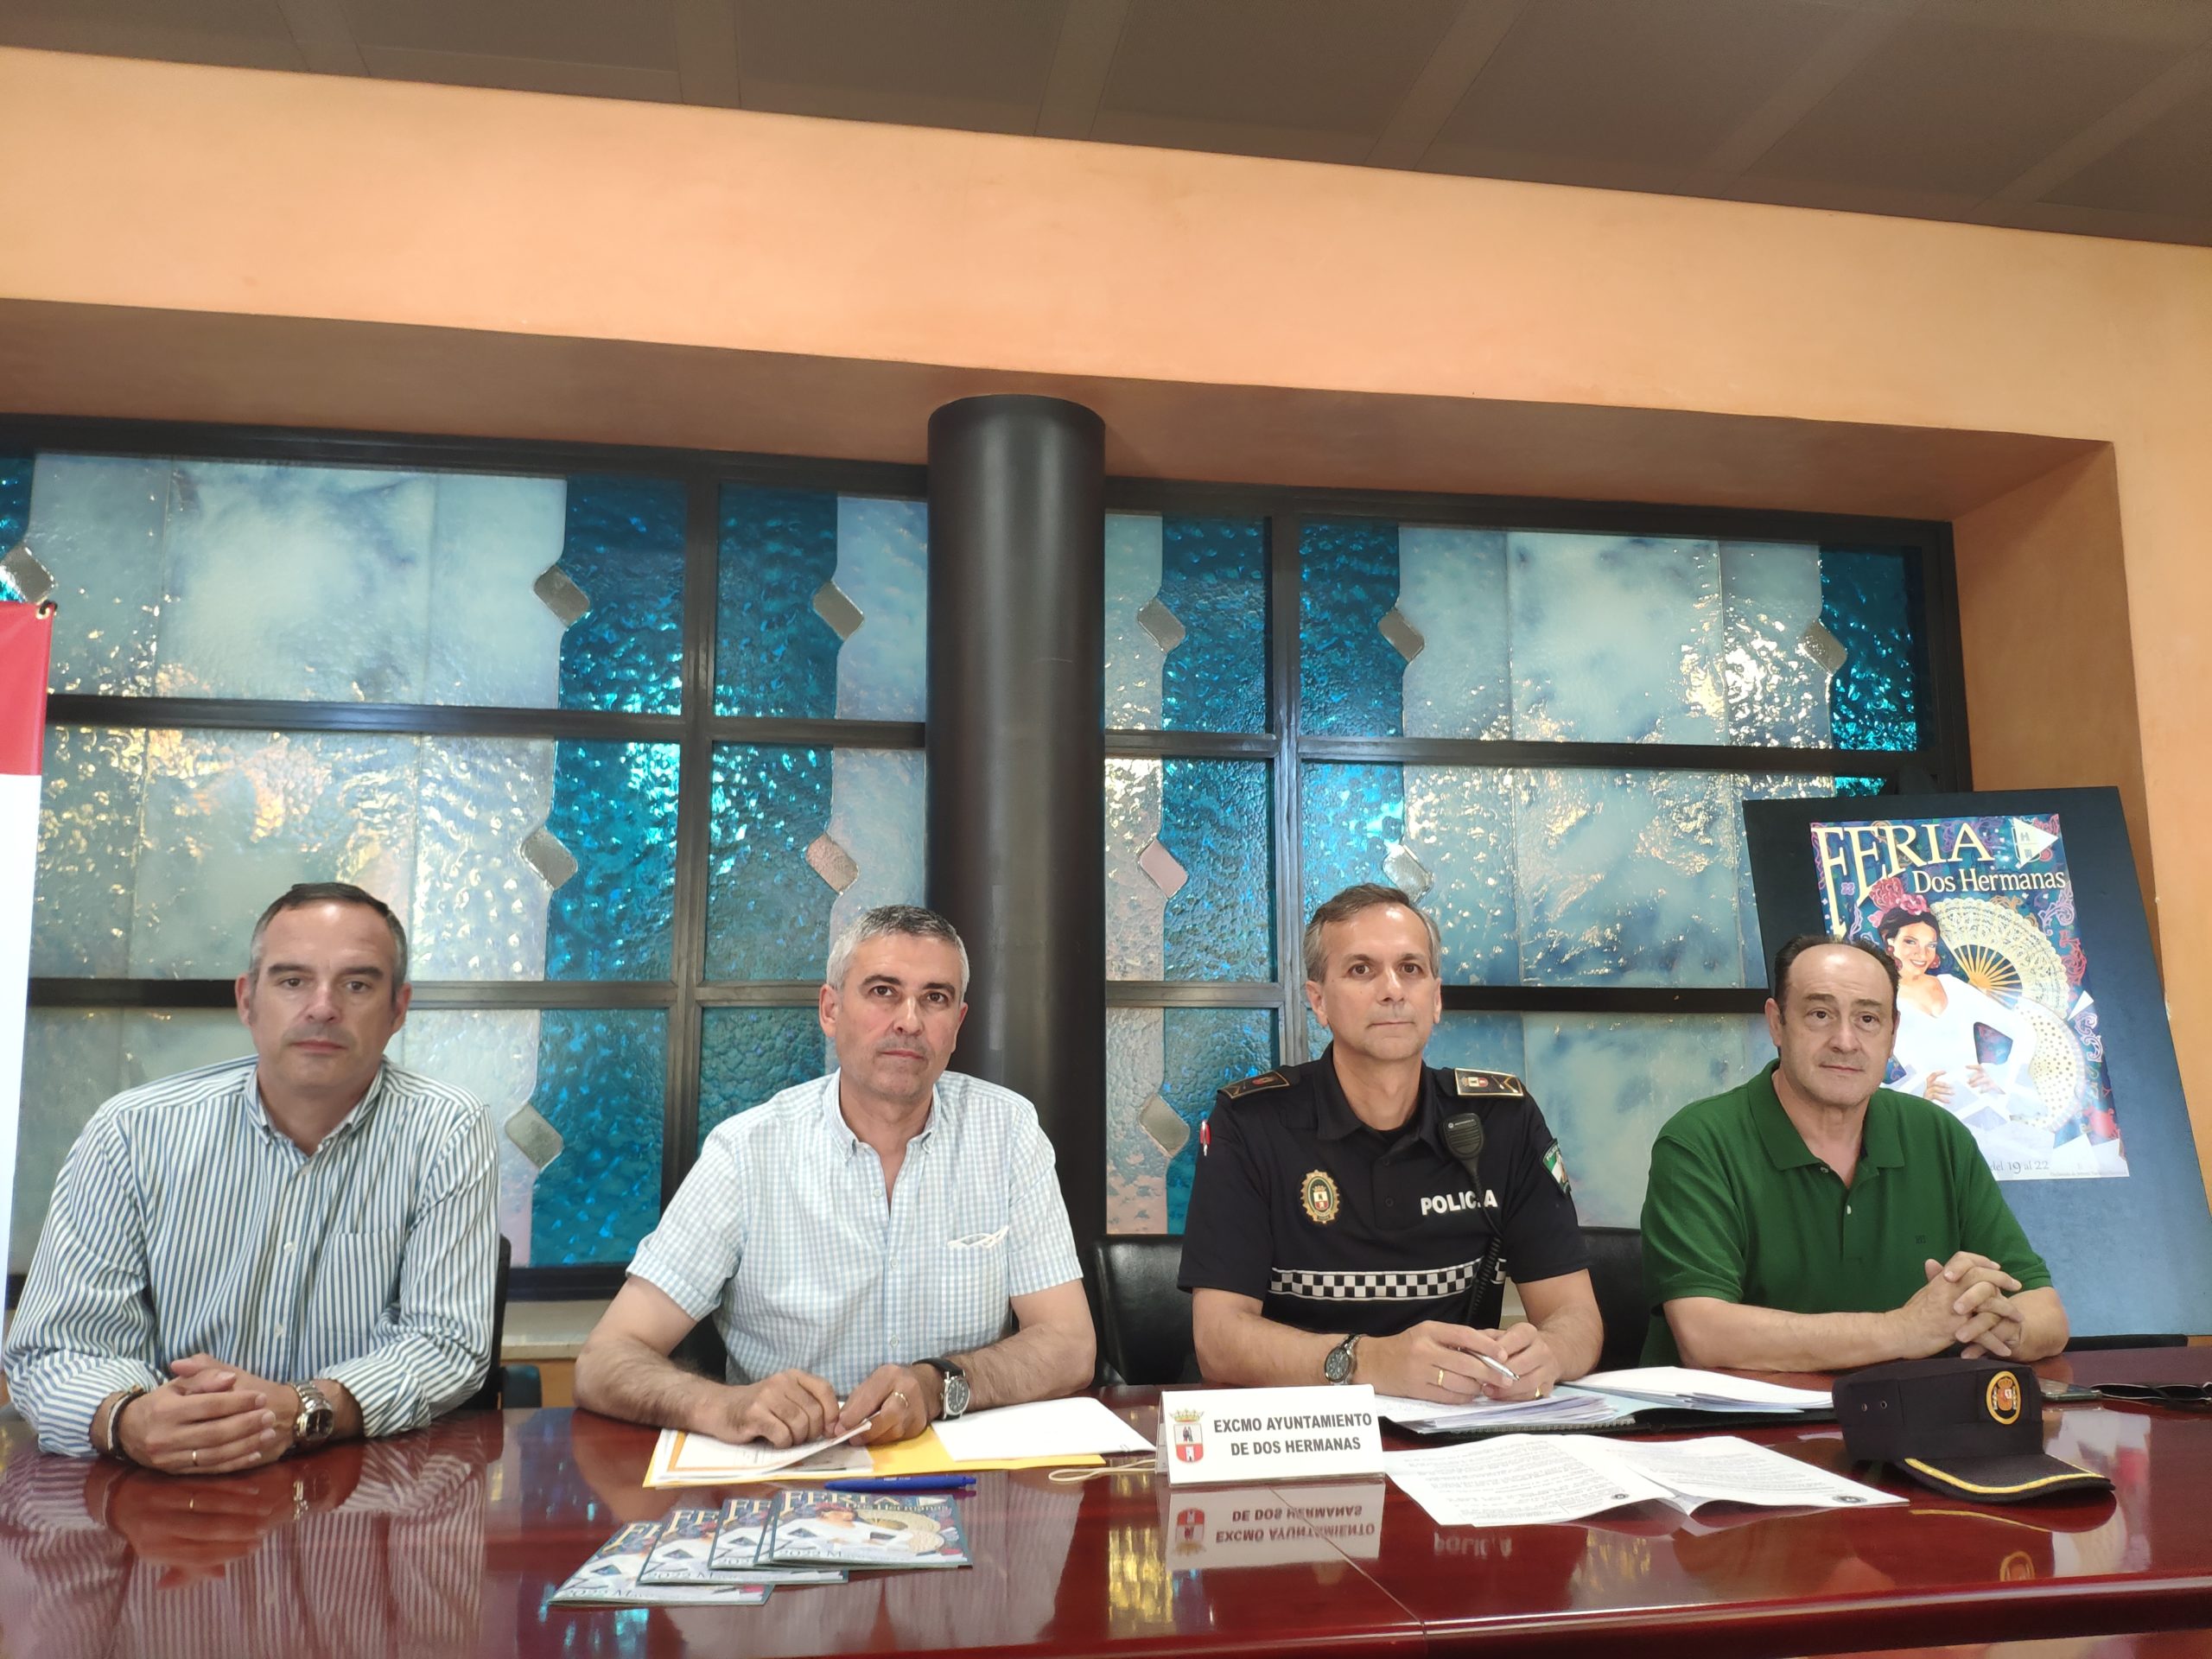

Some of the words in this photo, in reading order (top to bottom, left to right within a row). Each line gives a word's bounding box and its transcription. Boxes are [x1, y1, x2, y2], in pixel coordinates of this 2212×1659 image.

[1810, 822, 1995, 936] FERIA
[1913, 870, 1955, 893] Dos
[1959, 868, 2066, 892] Hermanas
[2007, 1161, 2021, 1174] 19
[2034, 1160, 2050, 1171] 22
[1420, 1189, 1498, 1216] POLICA
[1213, 1417, 1262, 1433] EXCMO
[1266, 1413, 1372, 1431] AYUNTAMIENTO
[1230, 1442, 1249, 1456] DE
[1253, 1440, 1281, 1454] DOS
[1286, 1437, 1361, 1452] HERMANAS
